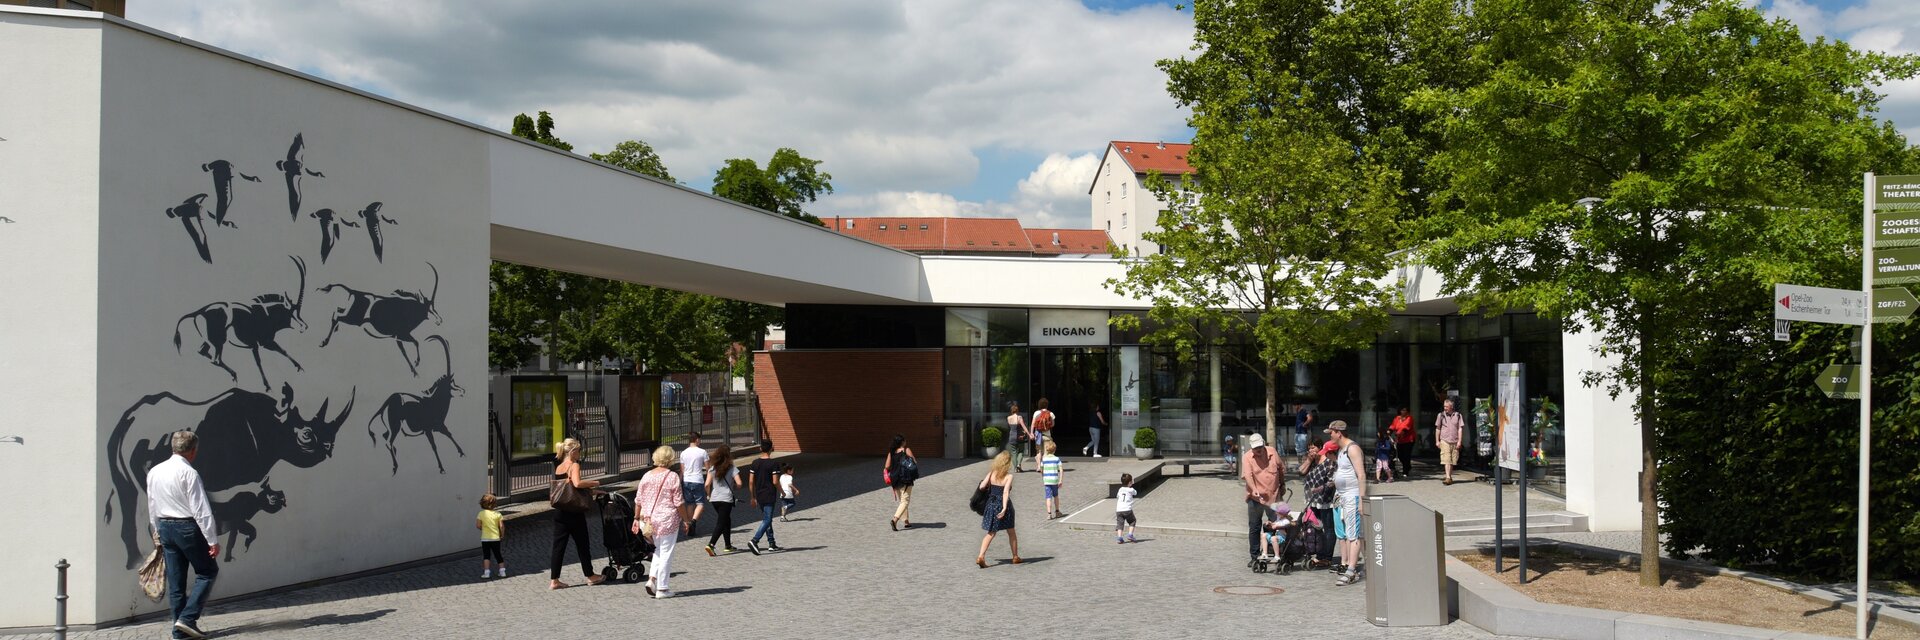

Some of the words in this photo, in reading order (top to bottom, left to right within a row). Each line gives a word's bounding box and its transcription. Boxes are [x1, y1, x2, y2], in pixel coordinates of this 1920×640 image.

[1882, 190, 1920, 198] THEATER
[1882, 218, 1920, 227] ZOOGES
[1878, 257, 1899, 265] ZOO-
[1791, 292, 1813, 303] Opel-Zoo
[1877, 300, 1906, 308] ZGF/FZS
[1791, 303, 1823, 315] Eschenheimer
[1823, 306, 1831, 315] Tor
[1042, 327, 1096, 336] EINGANG
[1831, 376, 1848, 384] ZOO
[1375, 534, 1383, 567] Abfälle
